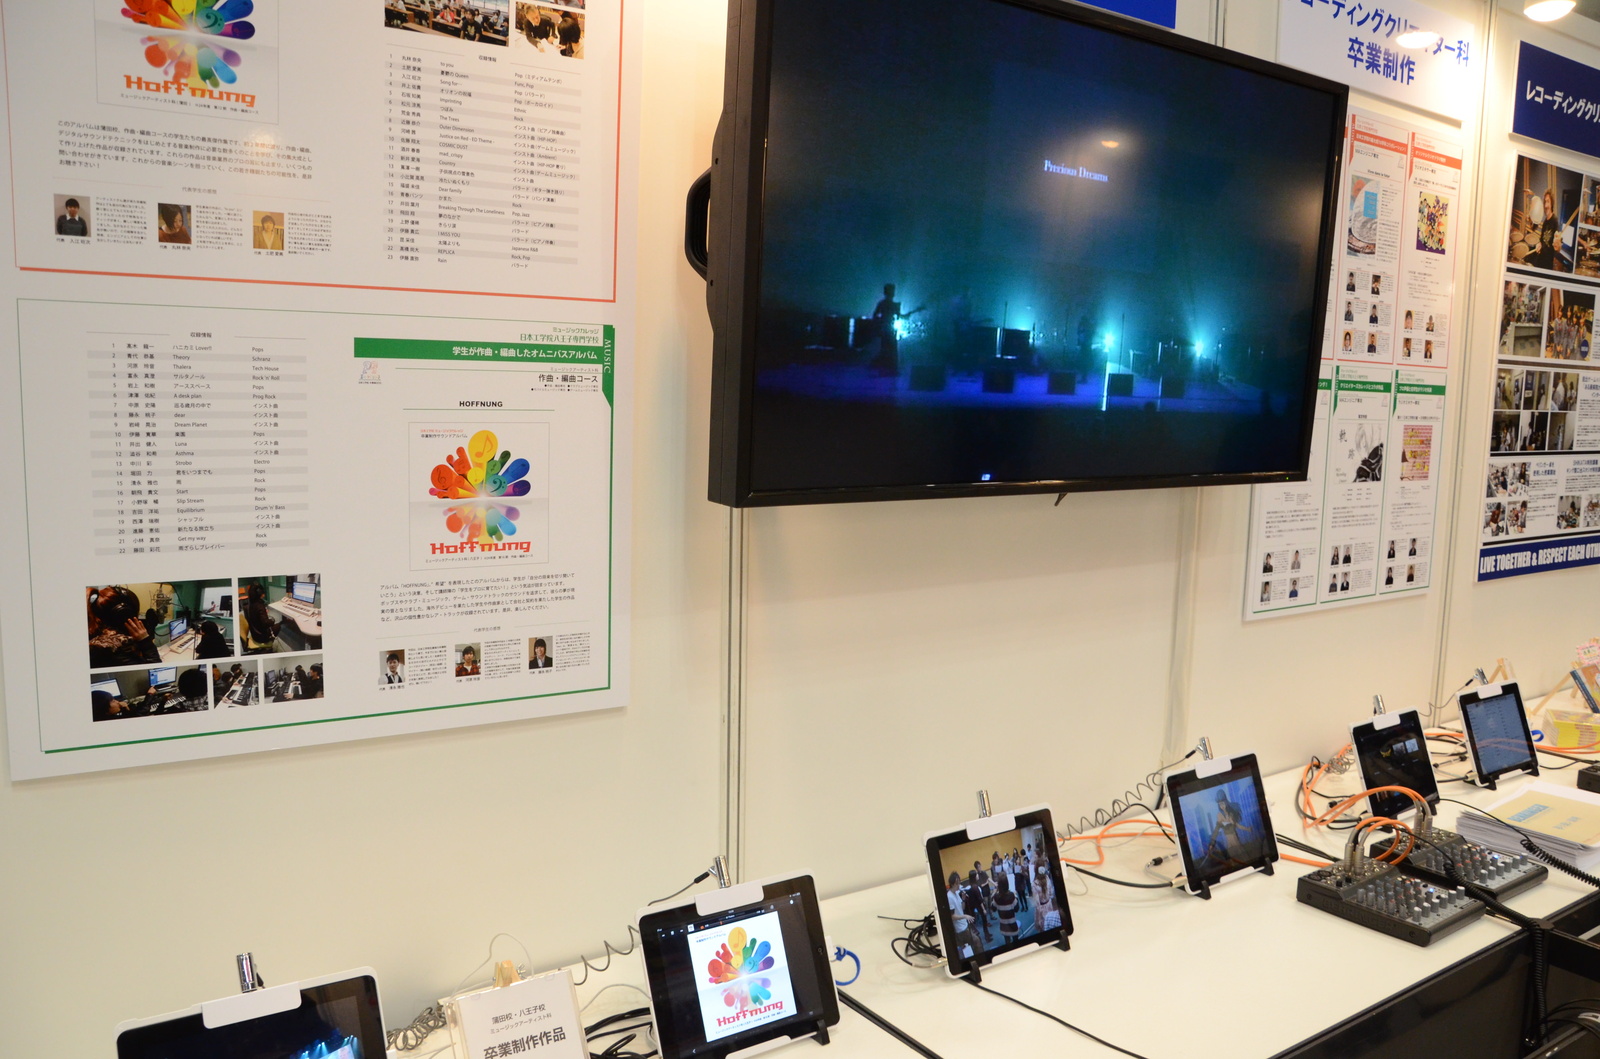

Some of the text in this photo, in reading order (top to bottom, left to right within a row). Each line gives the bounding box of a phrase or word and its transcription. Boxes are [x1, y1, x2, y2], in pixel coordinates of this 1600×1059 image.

[1347, 36, 1416, 86] 卒業制作
[123, 74, 256, 108] Hoffnung
[519, 333, 600, 344] 日本工学院八王子専門学校
[452, 346, 598, 360] 学生が作曲・編曲したオムニバスアルバム
[603, 338, 613, 374] MUSIC
[538, 374, 599, 383] 作曲・編曲コース
[459, 400, 503, 408] HOFFNUNG
[430, 541, 531, 555] Hoffnung
[1480, 542, 1600, 574] LIVE TOGETHER & RESPECT EACH OTH
[489, 1012, 552, 1035] ミュージックアーティスト科
[491, 1003, 547, 1025] 蒲田校・八王子校
[716, 1000, 785, 1029] Hoffnung
[483, 1026, 567, 1059] 卒業制作作品
